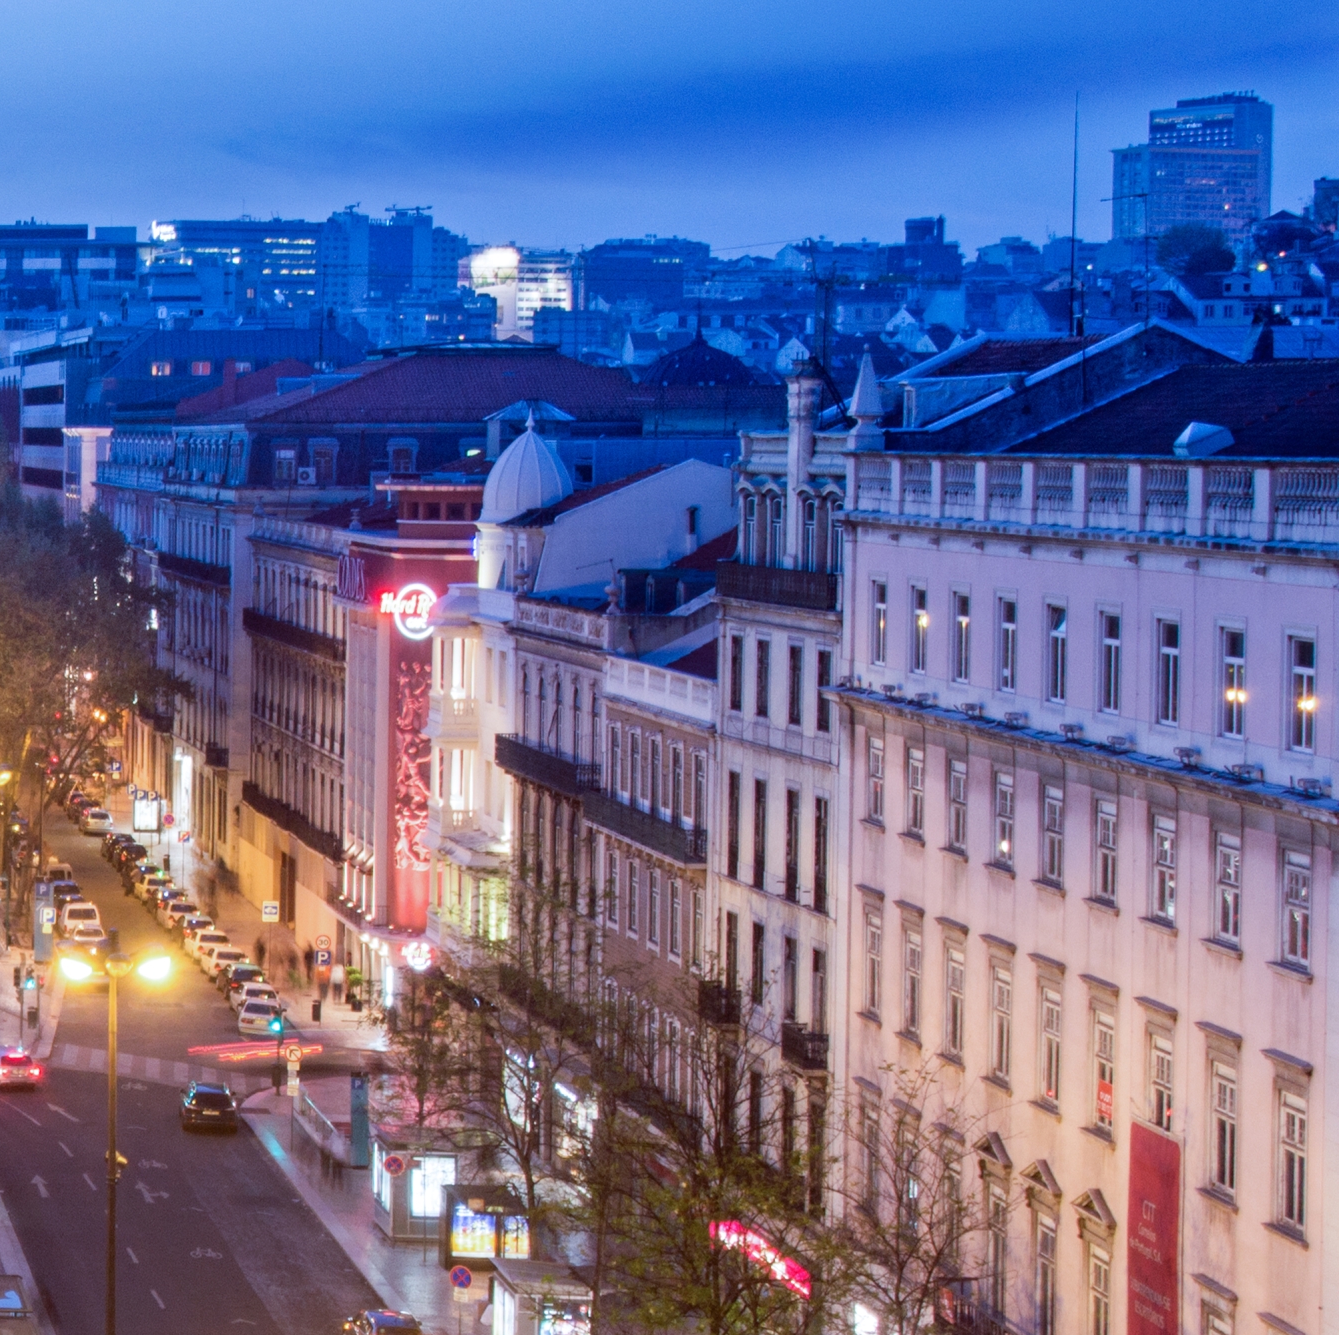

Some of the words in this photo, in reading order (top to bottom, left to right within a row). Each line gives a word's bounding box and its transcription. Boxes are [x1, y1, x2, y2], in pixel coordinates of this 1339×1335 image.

[381, 592, 417, 614] Hard
[317, 951, 329, 965] P
[1142, 1200, 1156, 1223] CTT
